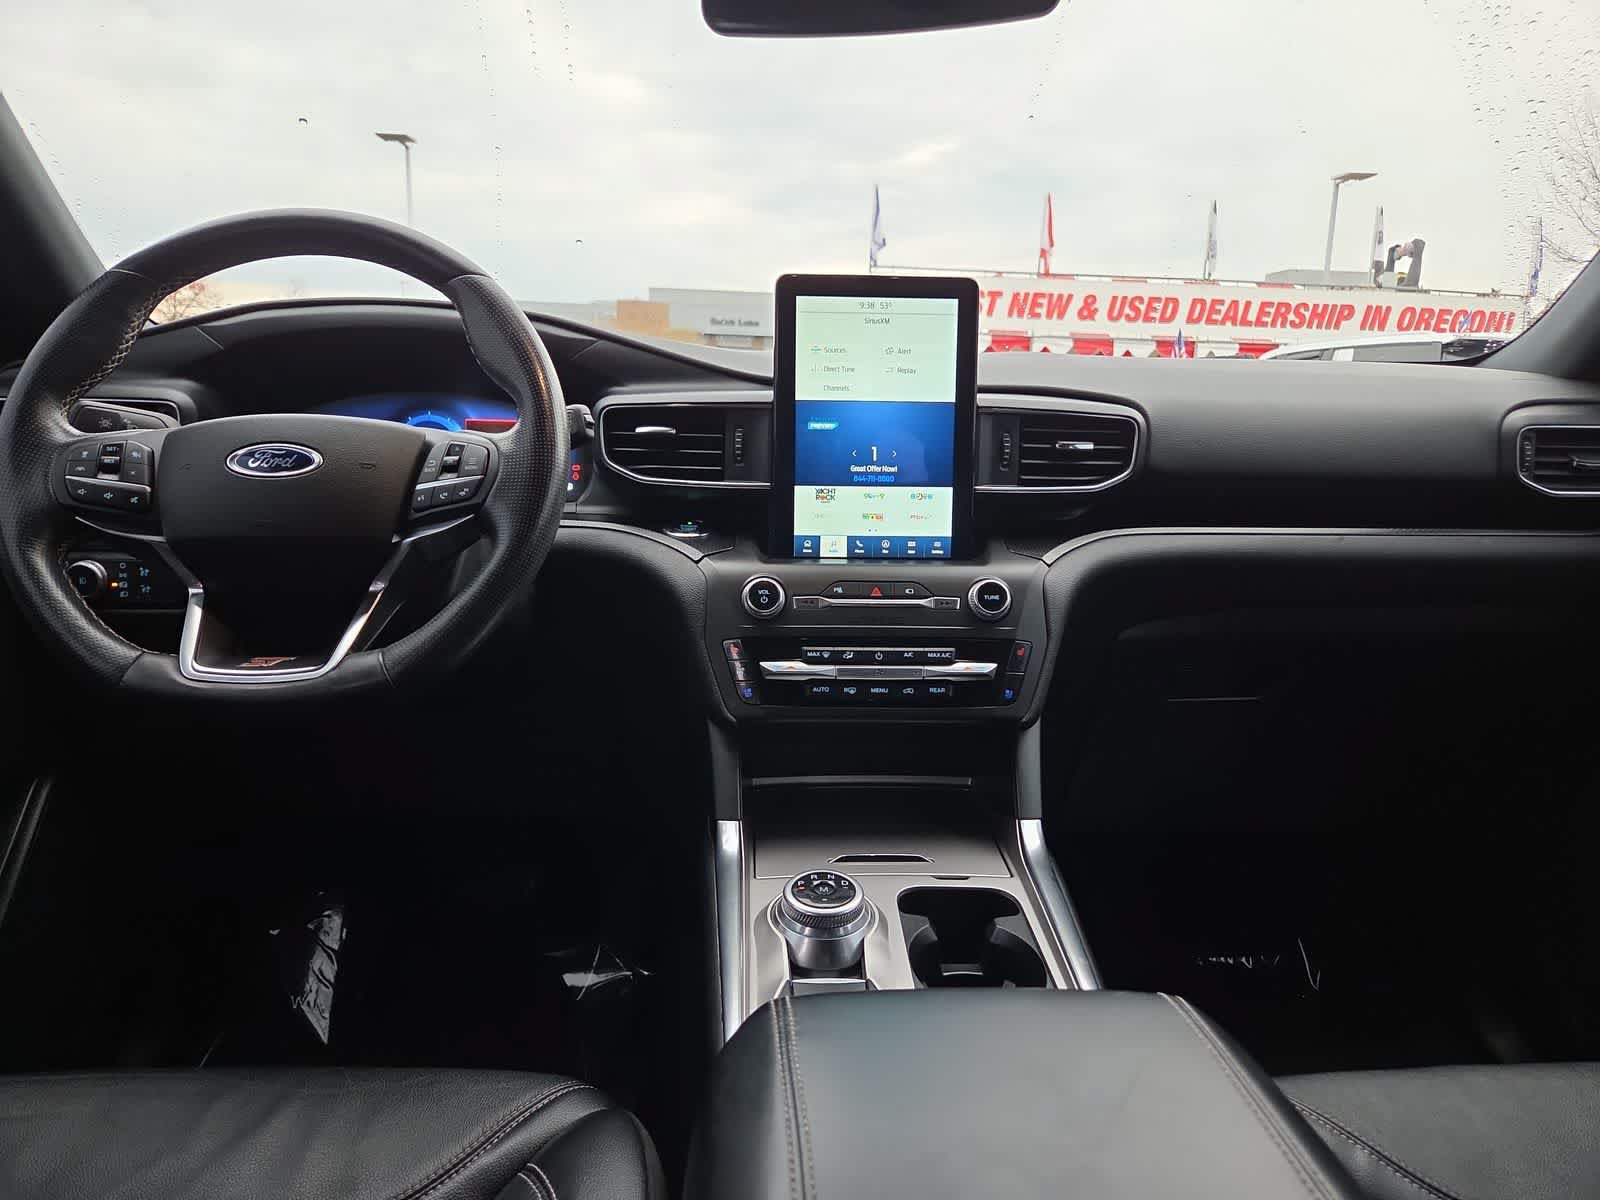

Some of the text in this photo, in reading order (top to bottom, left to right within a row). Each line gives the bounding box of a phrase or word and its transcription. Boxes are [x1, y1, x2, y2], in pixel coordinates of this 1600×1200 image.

[1007, 291, 1074, 321] NEW
[1077, 294, 1099, 322] &
[1107, 295, 1180, 325] USED
[1185, 298, 1356, 332] DEALERSHIP
[1360, 304, 1392, 332] IN
[864, 317, 890, 325] SiriusXM
[248, 449, 298, 468] Ford
[871, 446, 877, 461] 1
